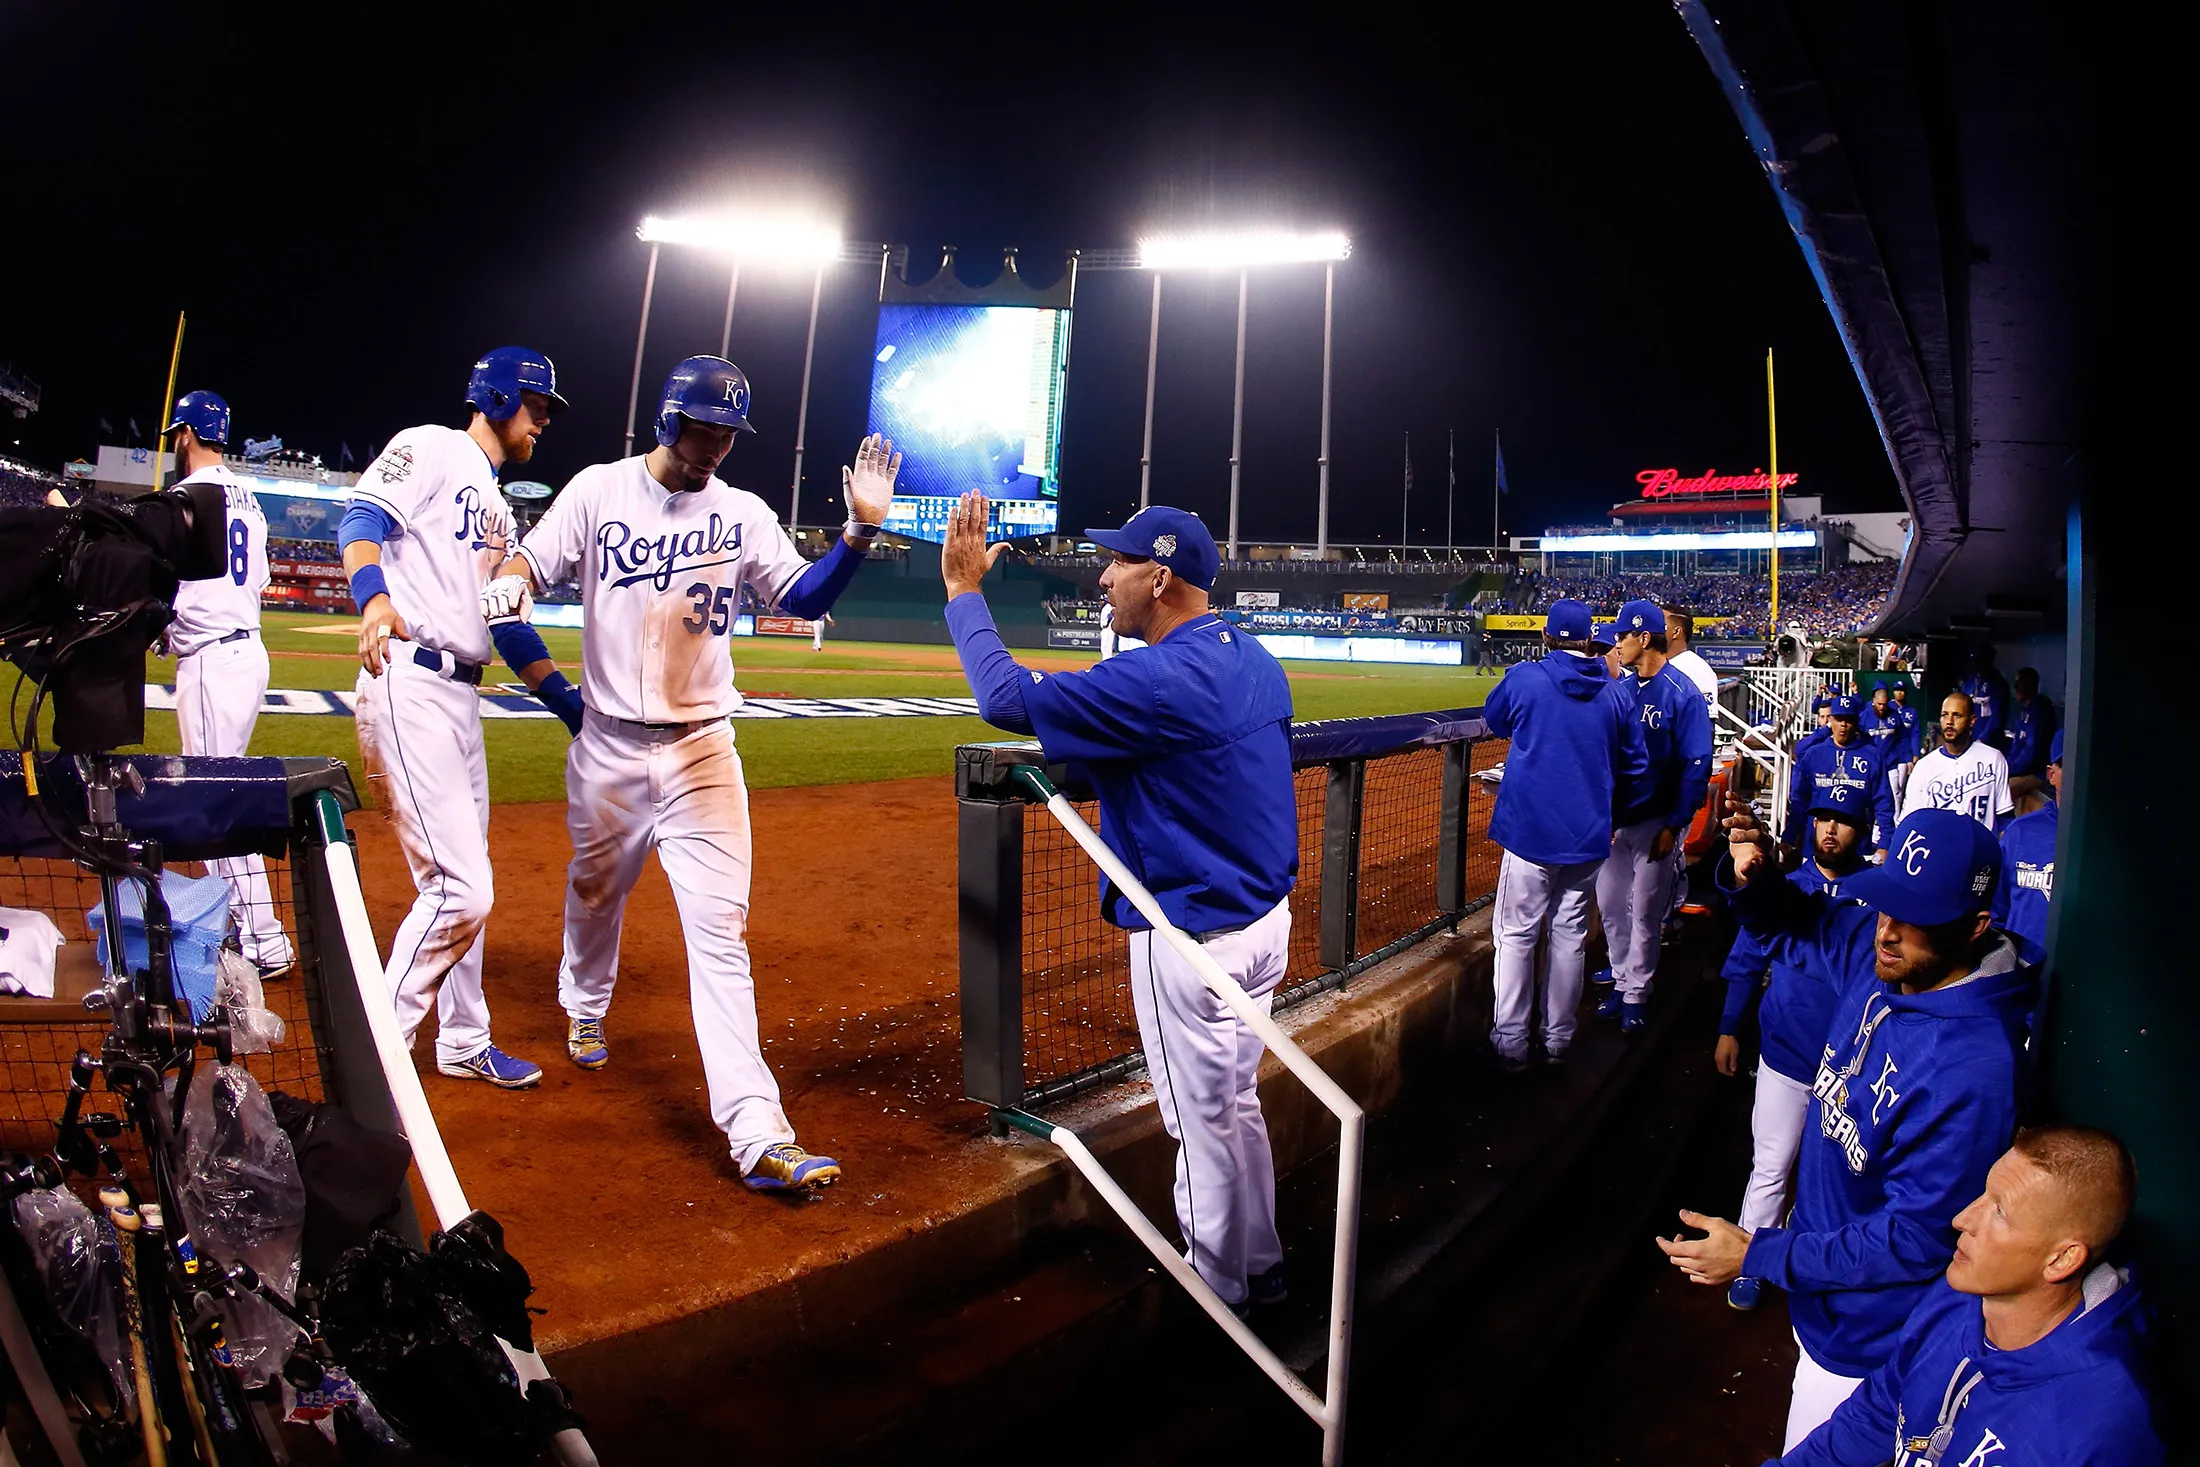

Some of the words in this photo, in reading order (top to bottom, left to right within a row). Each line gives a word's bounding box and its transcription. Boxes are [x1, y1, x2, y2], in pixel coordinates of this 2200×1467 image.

[723, 380, 744, 409] KC
[131, 447, 148, 463] 42
[229, 518, 248, 586] 8
[597, 513, 742, 591] Royals
[683, 582, 734, 636] 35
[1506, 619, 1527, 628] Sprint
[1503, 641, 1546, 660] Sprint
[1840, 697, 1850, 708] KC
[1641, 704, 1662, 730] KC
[1852, 756, 1868, 773] KC
[1830, 786, 1848, 802] KC
[1927, 761, 1997, 809] Royals
[1970, 795, 1990, 820] 15
[1897, 829, 1931, 876] KC
[1869, 1052, 1901, 1127] KC
